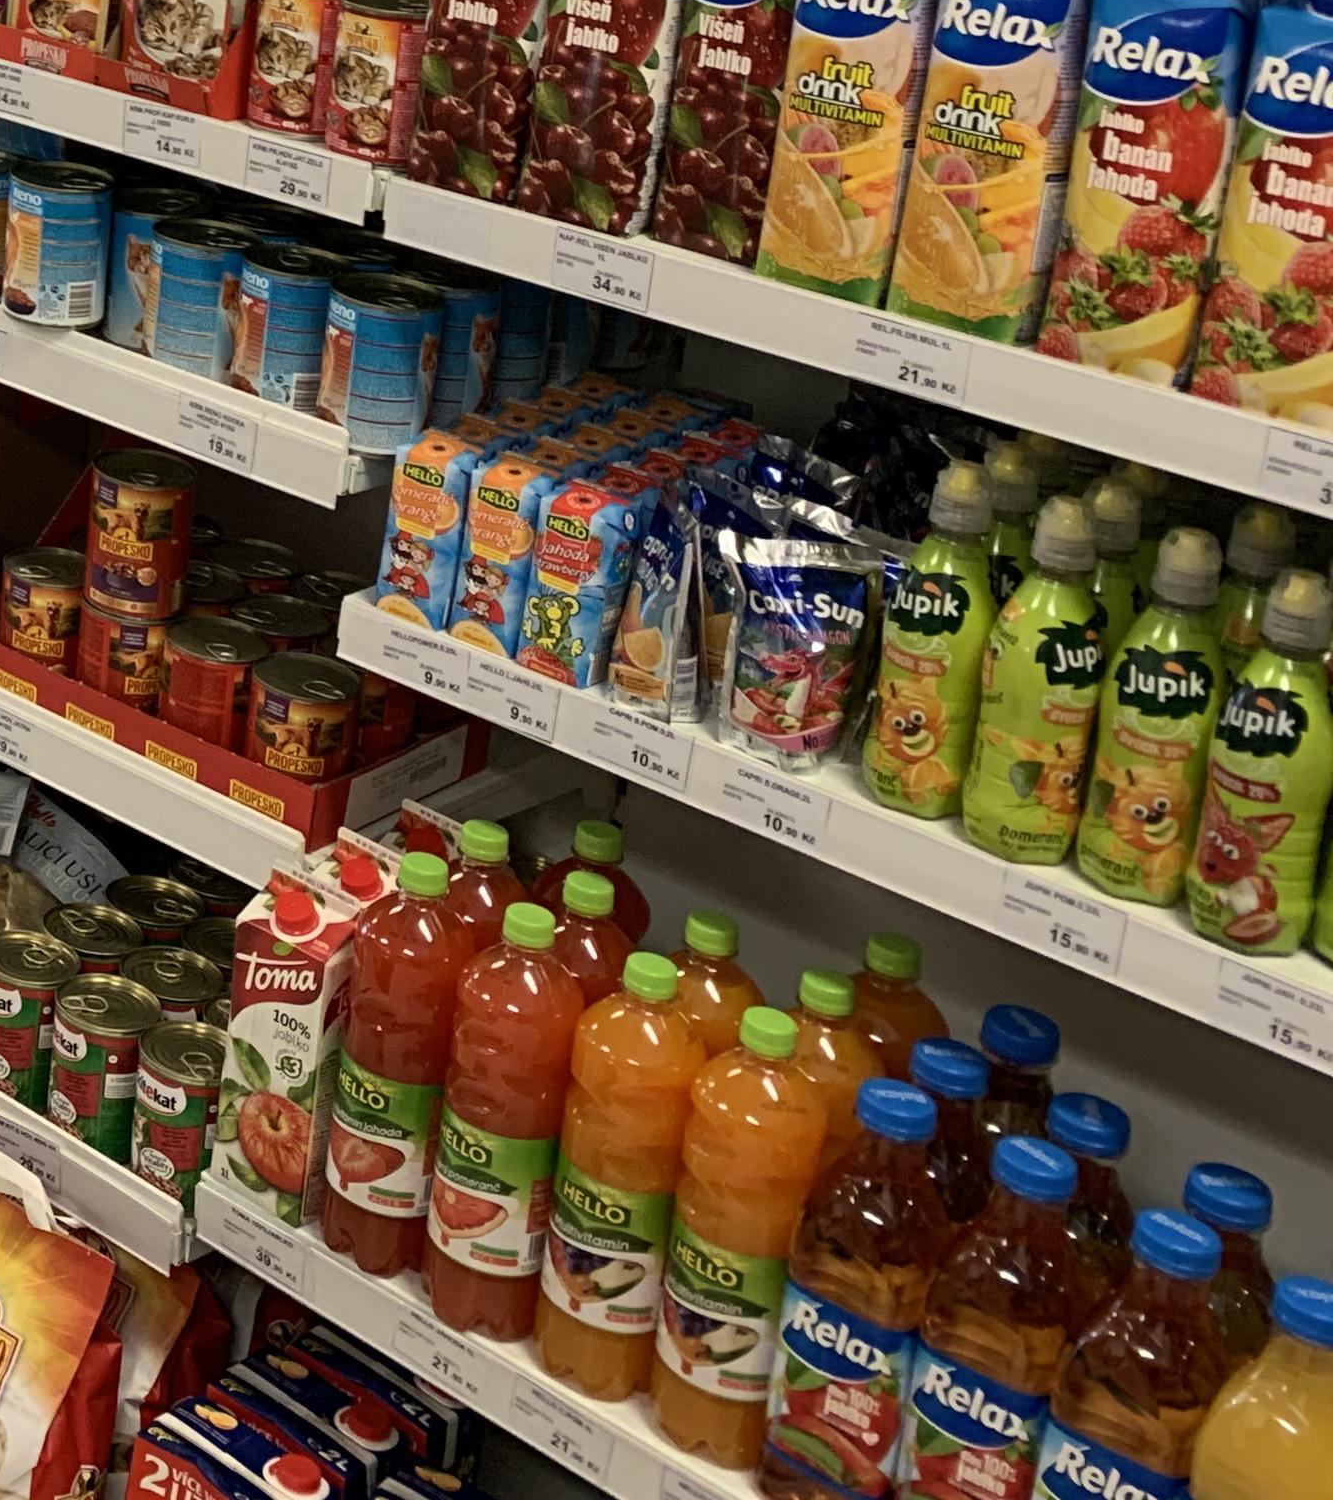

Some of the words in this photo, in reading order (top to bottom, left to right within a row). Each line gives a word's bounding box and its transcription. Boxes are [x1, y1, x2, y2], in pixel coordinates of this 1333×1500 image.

[565, 17, 620, 56] jablko
[1091, 26, 1211, 85] Relax
[698, 39, 752, 78] jablko
[823, 54, 875, 89] fruit
[789, 94, 882, 128] MULTIVITAMIN
[961, 84, 1015, 118] fruit
[924, 125, 1025, 160] MULTIVITAMIN
[1101, 128, 1173, 173] banán
[1086, 160, 1158, 202] jahoda
[1247, 196, 1327, 238] jahoda
[405, 464, 442, 485] HELLO
[480, 489, 517, 509] HELLO
[549, 516, 587, 538] HELLO
[100, 535, 152, 559] PROPESKO
[541, 541, 589, 562] jahoda
[749, 589, 865, 630] Capri-Sun
[891, 582, 959, 619] Jupik
[12, 633, 63, 657] PROPESKO
[1129, 662, 1205, 702] Jupik
[66, 706, 114, 739] PROPESKO
[1220, 699, 1296, 738] Jupik
[146, 743, 197, 779] PROPESKO
[267, 752, 325, 775] PROPESKO
[231, 783, 284, 818] PROPESKO
[235, 949, 318, 992] Toma
[272, 1008, 312, 1040] 100%
[339, 1068, 385, 1110] HELLO
[564, 1180, 625, 1224] HELLO
[554, 1213, 630, 1251] Multivitamin
[677, 1238, 738, 1287] HELLO
[790, 1299, 893, 1377] Relax
[922, 1362, 1030, 1442] Relax
[139, 1454, 167, 1495] 2
